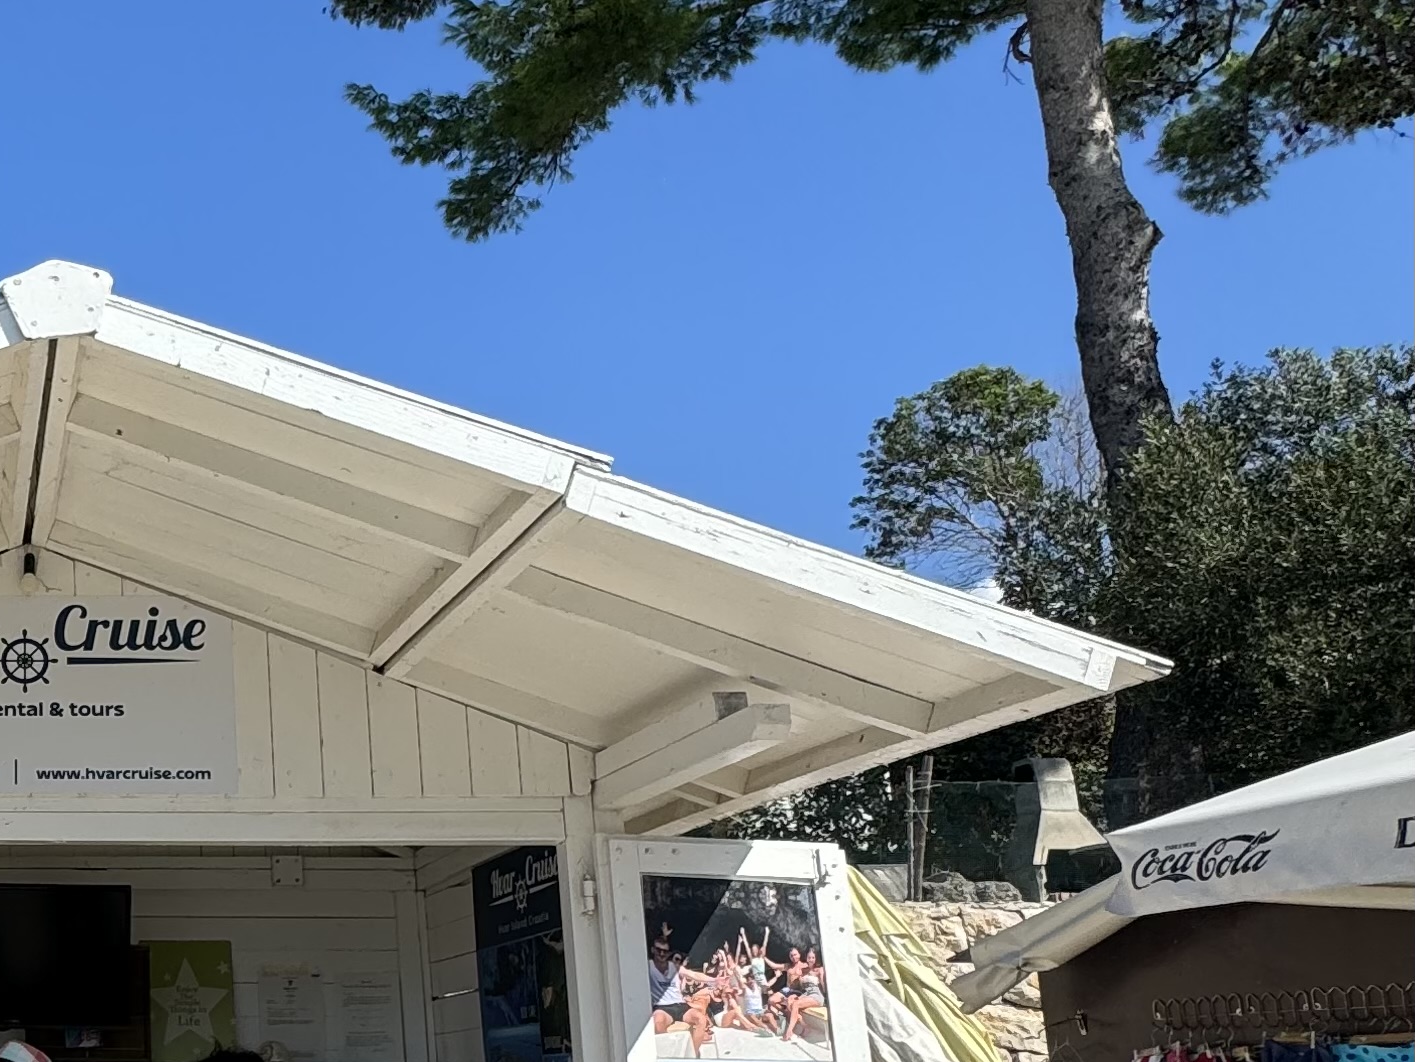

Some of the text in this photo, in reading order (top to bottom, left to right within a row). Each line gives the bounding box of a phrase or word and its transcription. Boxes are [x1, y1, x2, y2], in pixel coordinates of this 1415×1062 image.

[53, 603, 206, 652] Cruise
[49, 702, 64, 718] &
[69, 703, 124, 718] tours
[36, 766, 211, 780] www.hvarcruise.com
[1131, 828, 1281, 890] Coca-Cola
[178, 1015, 201, 1026] Life
